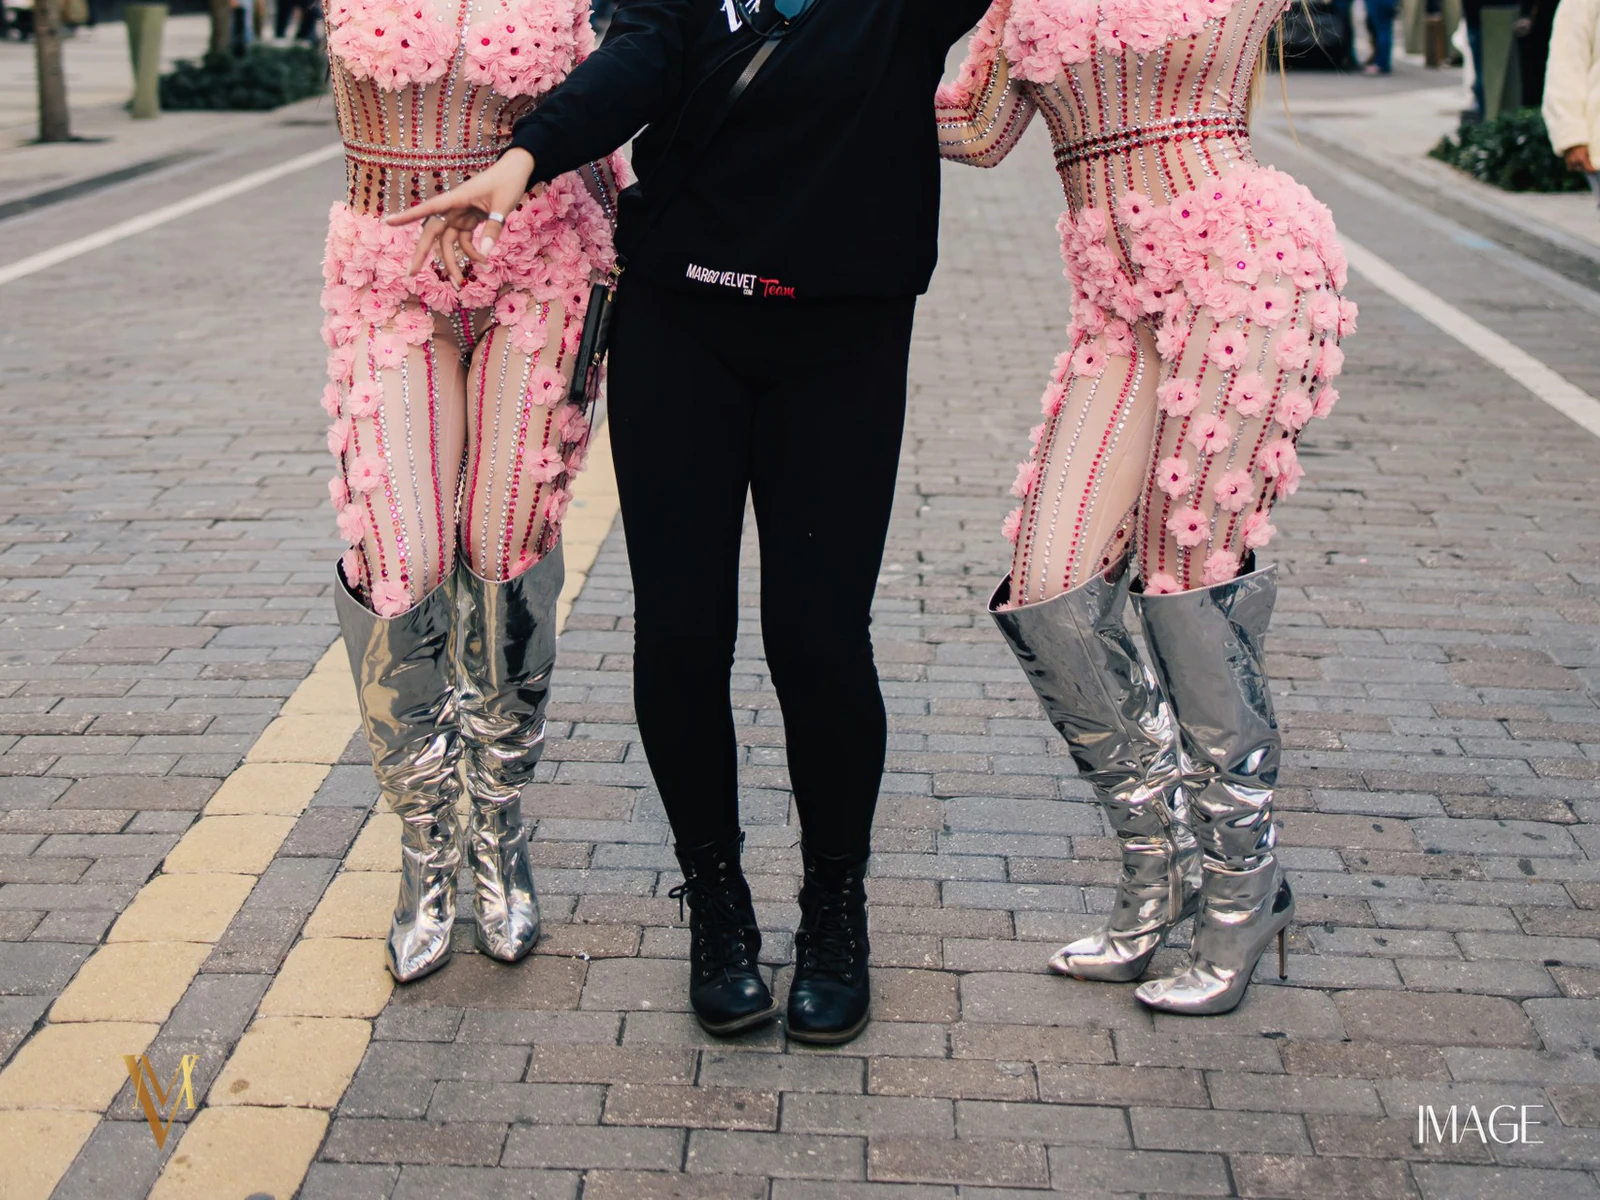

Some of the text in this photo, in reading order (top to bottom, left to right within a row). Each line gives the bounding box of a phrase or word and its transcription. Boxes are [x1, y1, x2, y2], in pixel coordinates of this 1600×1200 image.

[685, 263, 796, 299] MARGO VELVET Team
